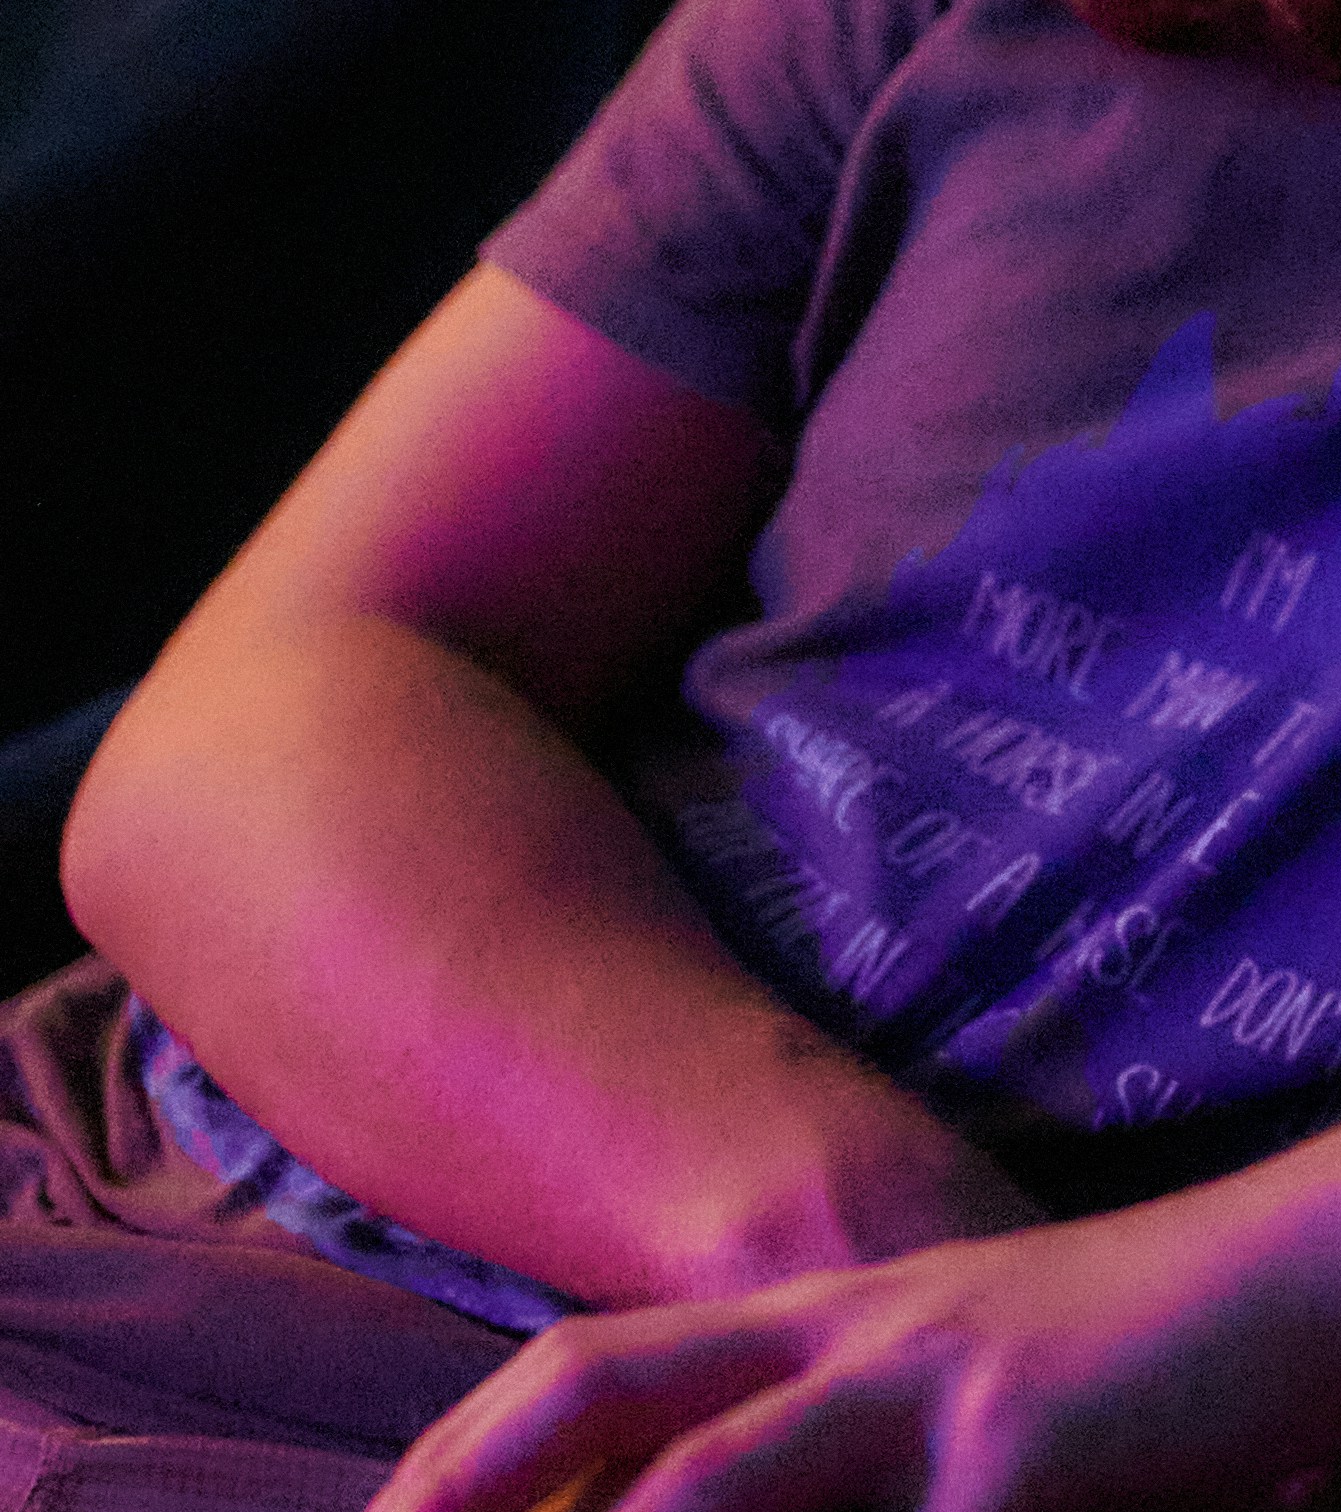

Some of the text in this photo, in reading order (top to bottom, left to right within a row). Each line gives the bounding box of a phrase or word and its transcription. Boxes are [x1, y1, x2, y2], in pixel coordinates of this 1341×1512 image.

[959, 569, 1125, 704] MORE
[1219, 529, 1320, 637] I'M
[889, 810, 993, 878] OF
[965, 851, 1042, 927] A
[1105, 770, 1193, 858] IN
